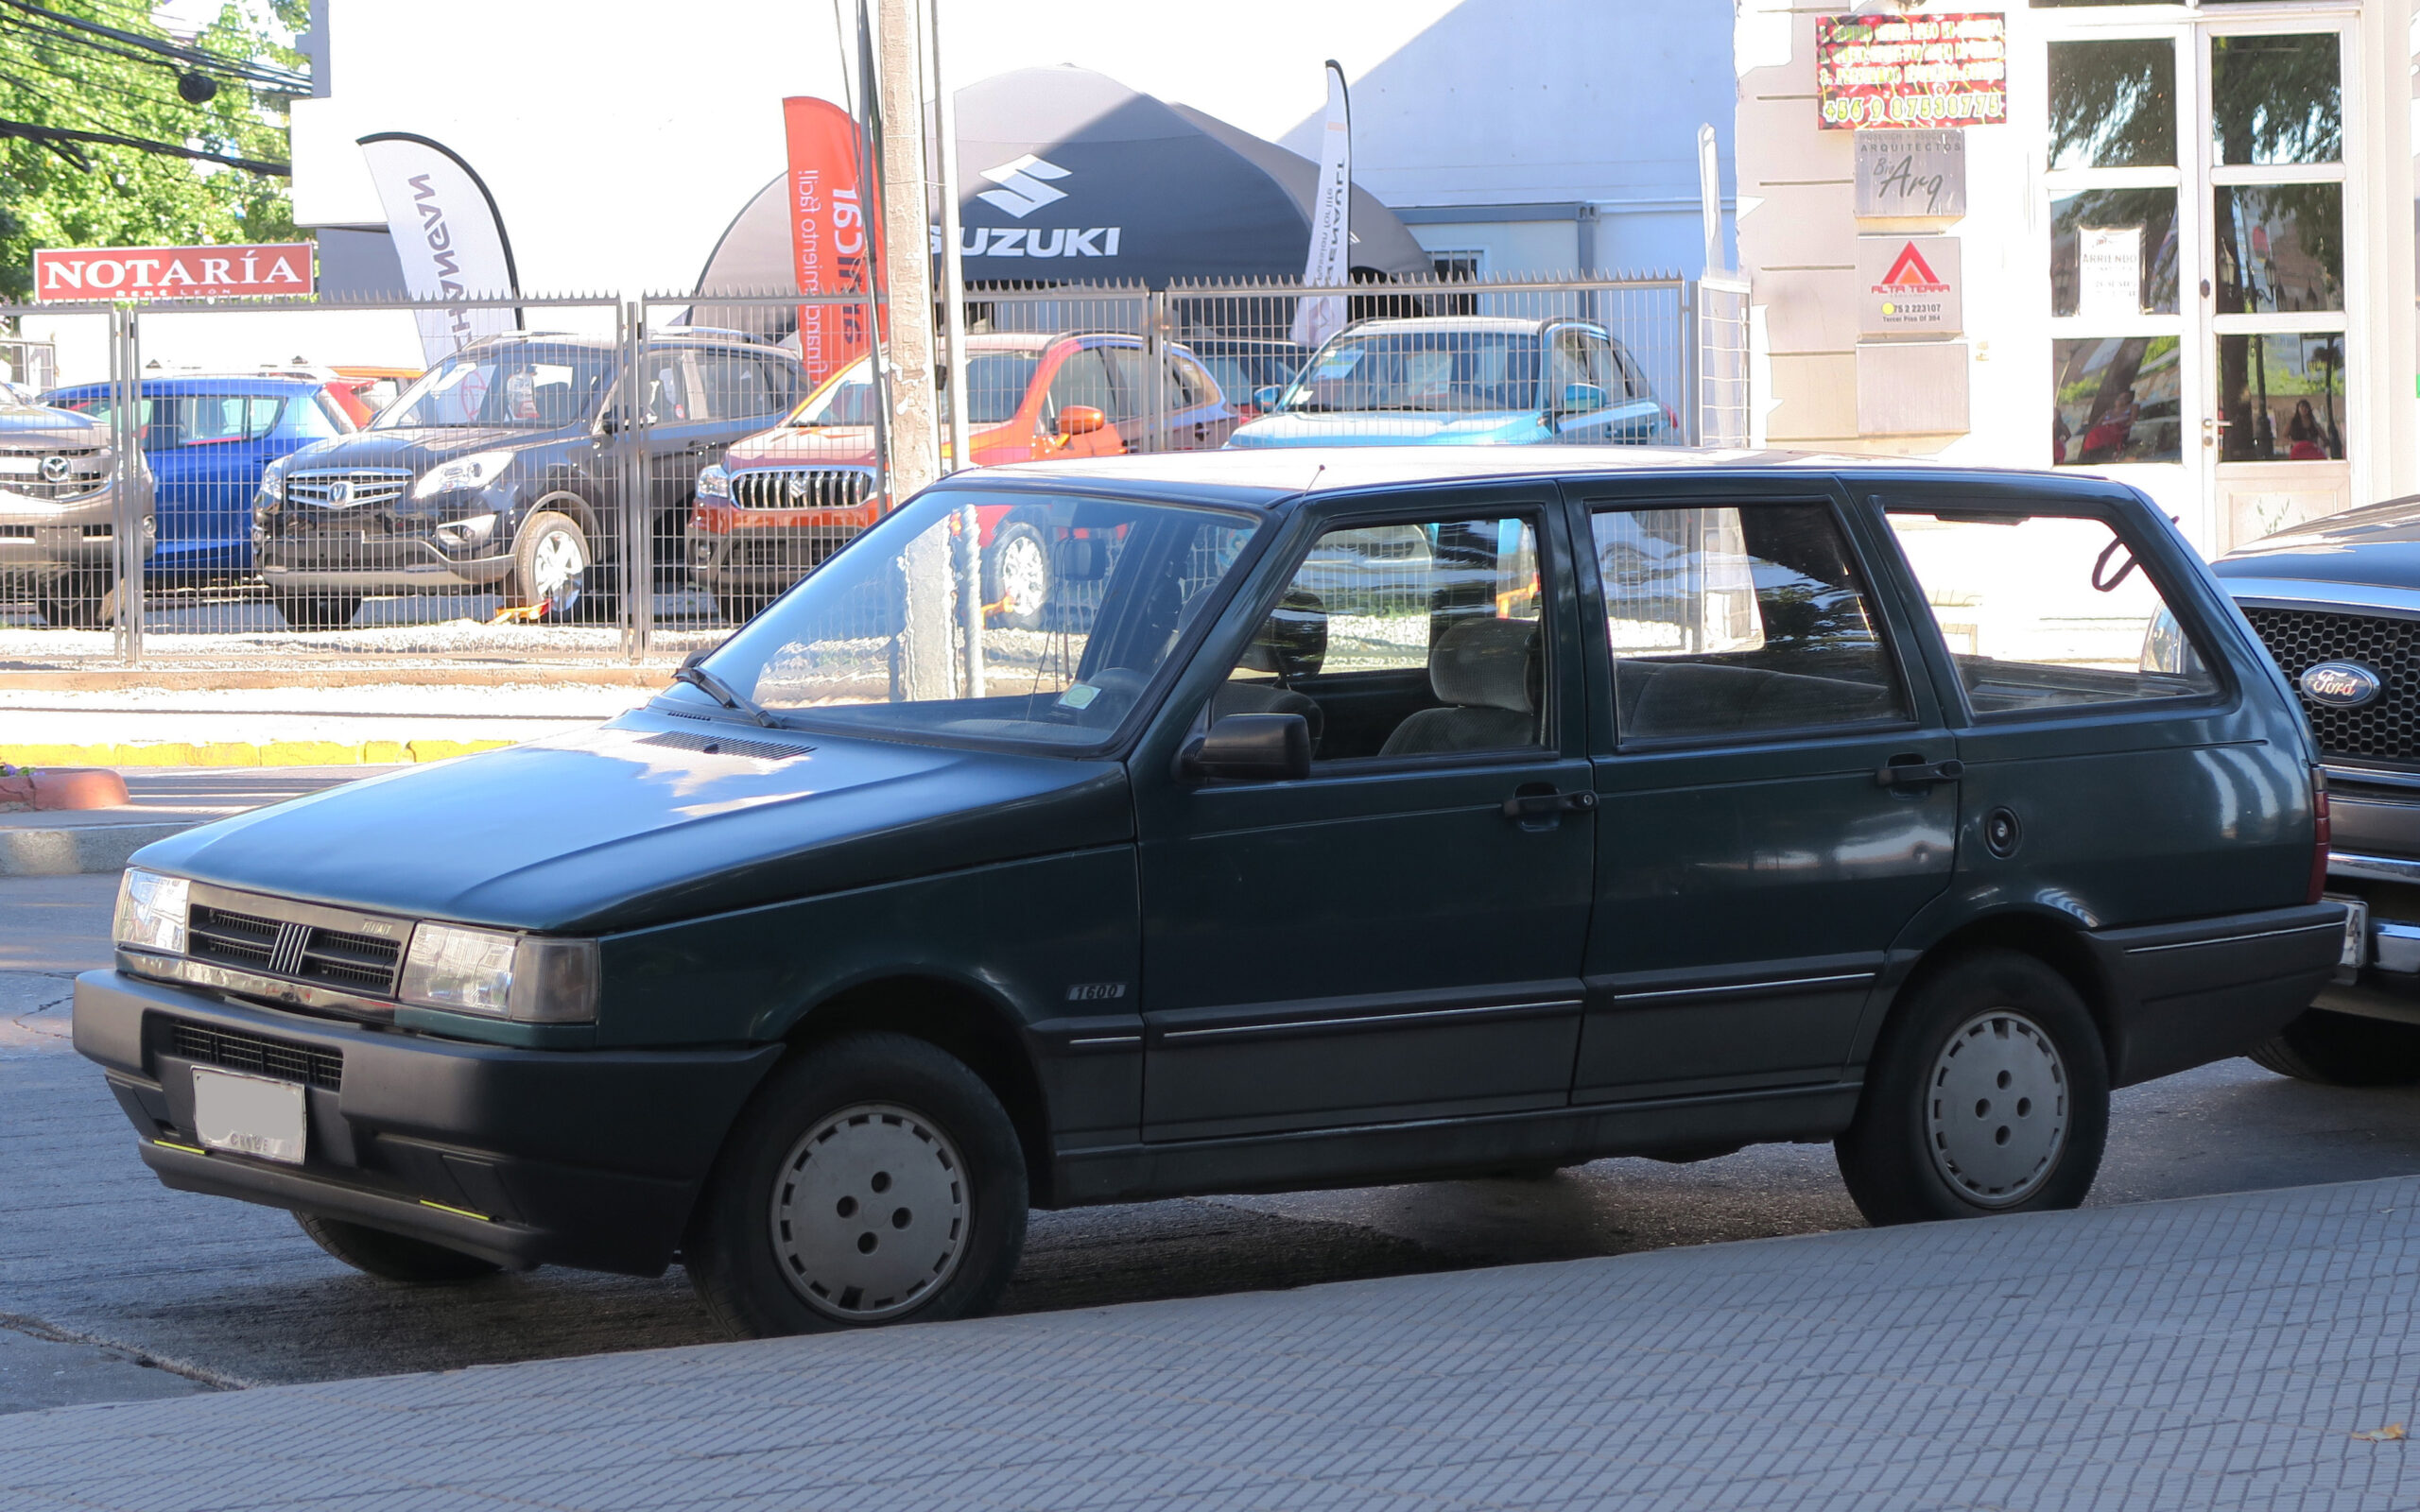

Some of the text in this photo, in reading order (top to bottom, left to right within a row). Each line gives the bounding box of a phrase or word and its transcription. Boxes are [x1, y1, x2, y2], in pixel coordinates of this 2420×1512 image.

[1824, 93, 2001, 121] +56 9 87538775
[1860, 143, 1962, 152] ARQUITECTOS
[43, 249, 302, 289] NOTARÍA
[1871, 285, 1906, 294] ALTA
[1905, 304, 1910, 313] 2
[1911, 303, 1942, 313] 223107
[2313, 669, 2359, 696] Ford
[362, 920, 394, 936] FIAT
